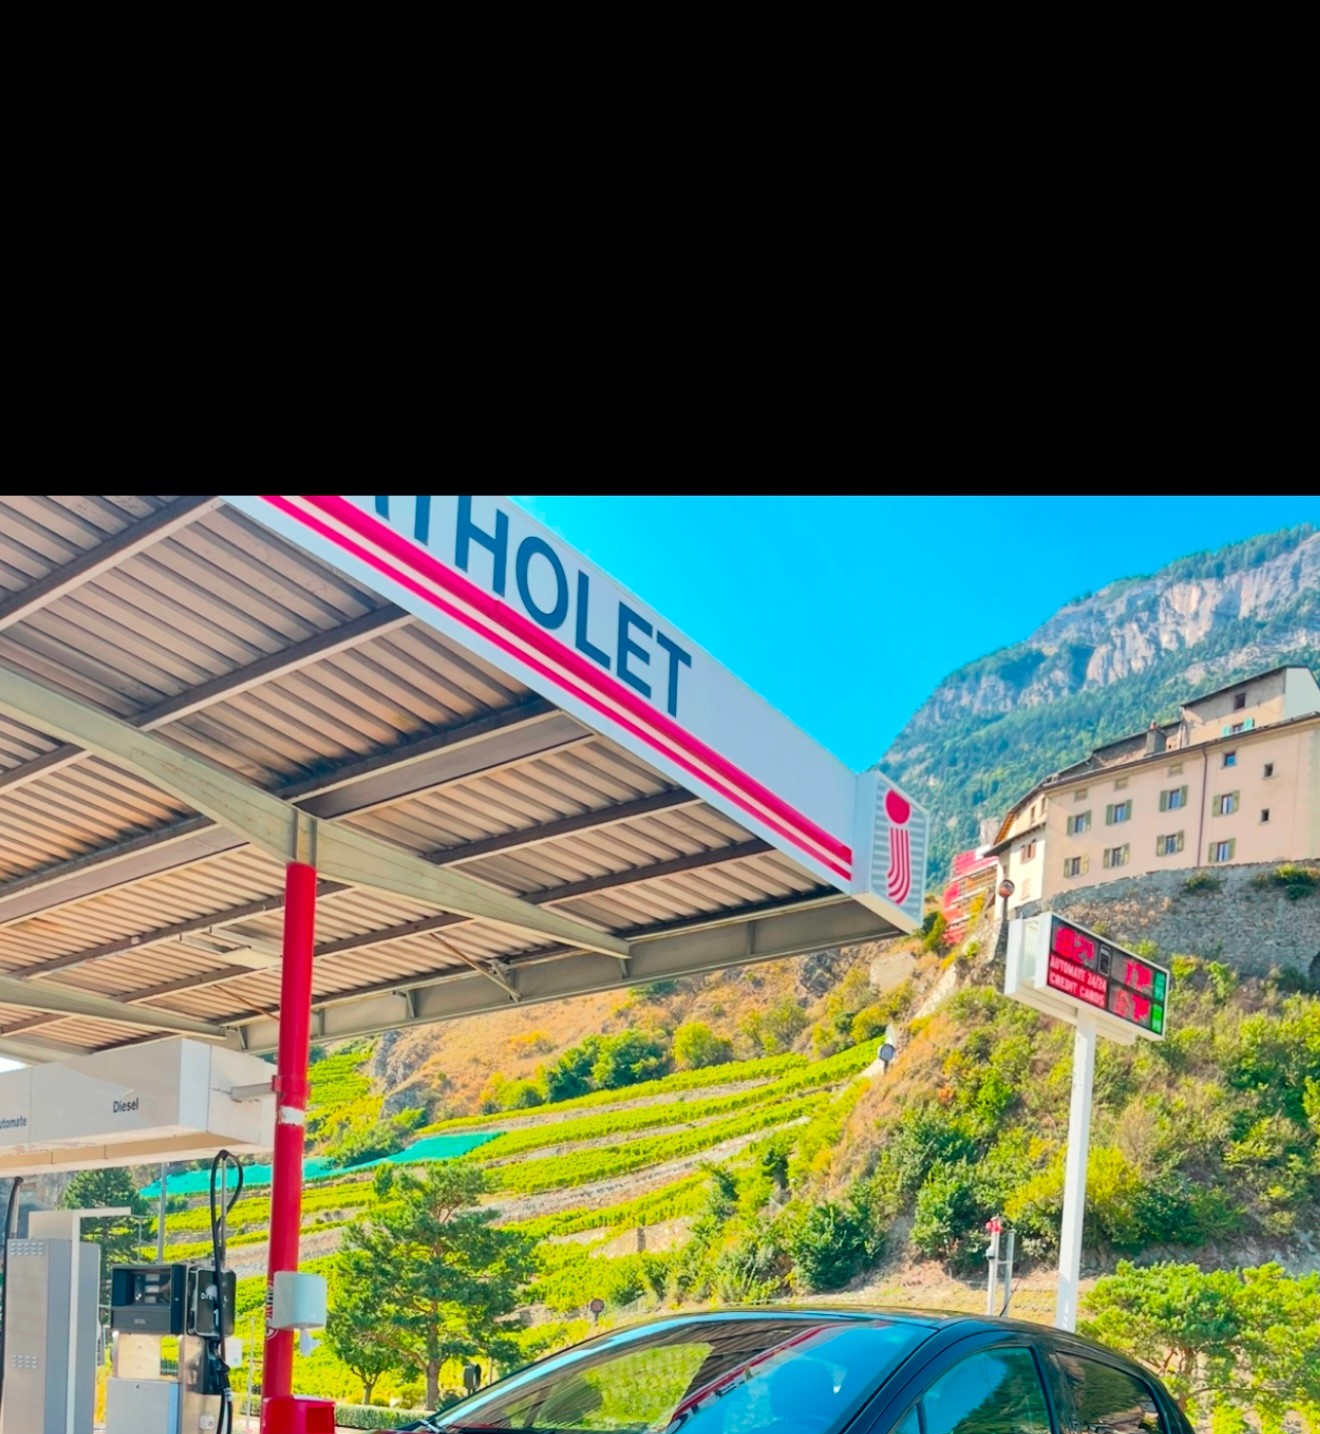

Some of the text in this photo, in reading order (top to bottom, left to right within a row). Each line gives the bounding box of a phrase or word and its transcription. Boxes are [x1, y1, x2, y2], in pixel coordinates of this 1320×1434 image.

[374, 494, 692, 719] HOLET
[1049, 954, 1086, 982] AUTOMATE
[1049, 971, 1079, 995] CREDIT
[113, 1097, 139, 1113] Diesel
[0, 1115, 27, 1129] utomate
[200, 1292, 229, 1302] DIEL
